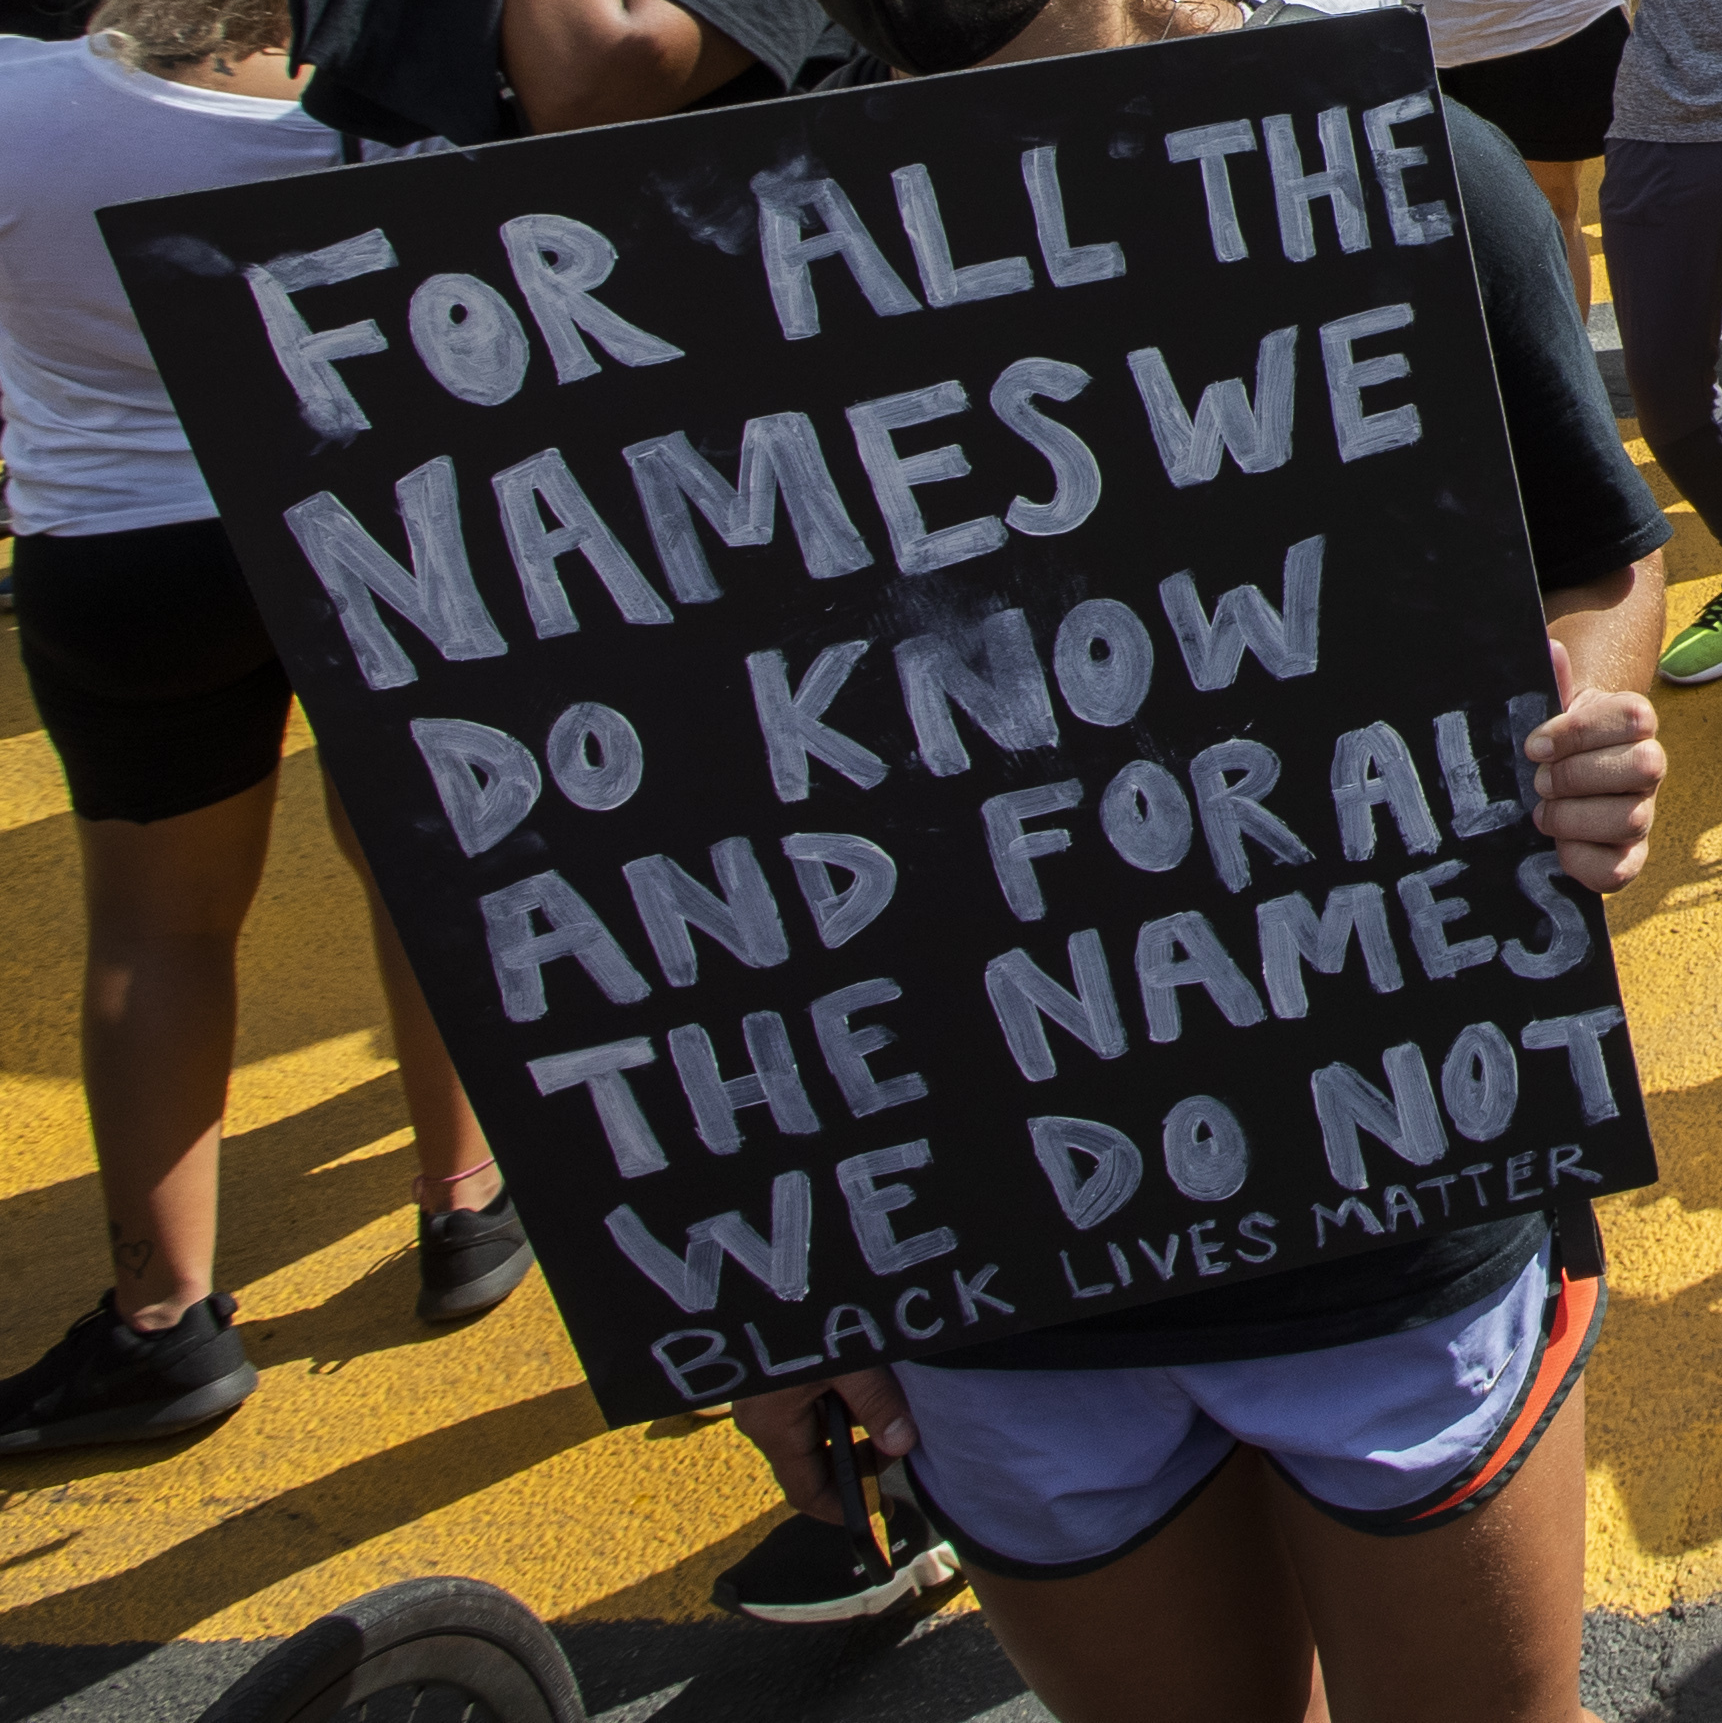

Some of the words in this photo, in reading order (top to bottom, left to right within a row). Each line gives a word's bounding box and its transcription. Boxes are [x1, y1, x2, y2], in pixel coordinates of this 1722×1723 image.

[244, 213, 685, 440] FOR
[756, 142, 1130, 342] ALL
[1164, 89, 1458, 264] THE
[282, 354, 1104, 691] NAMES
[1127, 302, 1425, 490] WE
[407, 700, 645, 858] DO
[745, 532, 1327, 804] KNOW
[475, 830, 899, 1024] AND
[979, 738, 1316, 922] FOR
[1330, 692, 1548, 862] ALL
[524, 976, 929, 1178] THE
[984, 847, 1596, 1082] NAMES
[603, 1136, 958, 1314] WE
[1028, 1092, 1253, 1234] DO
[1310, 1002, 1625, 1191] NOT
[646, 1261, 1018, 1403] BLACK
[1059, 1209, 1281, 1301] LIVES
[1307, 1141, 1605, 1249] MATTER
